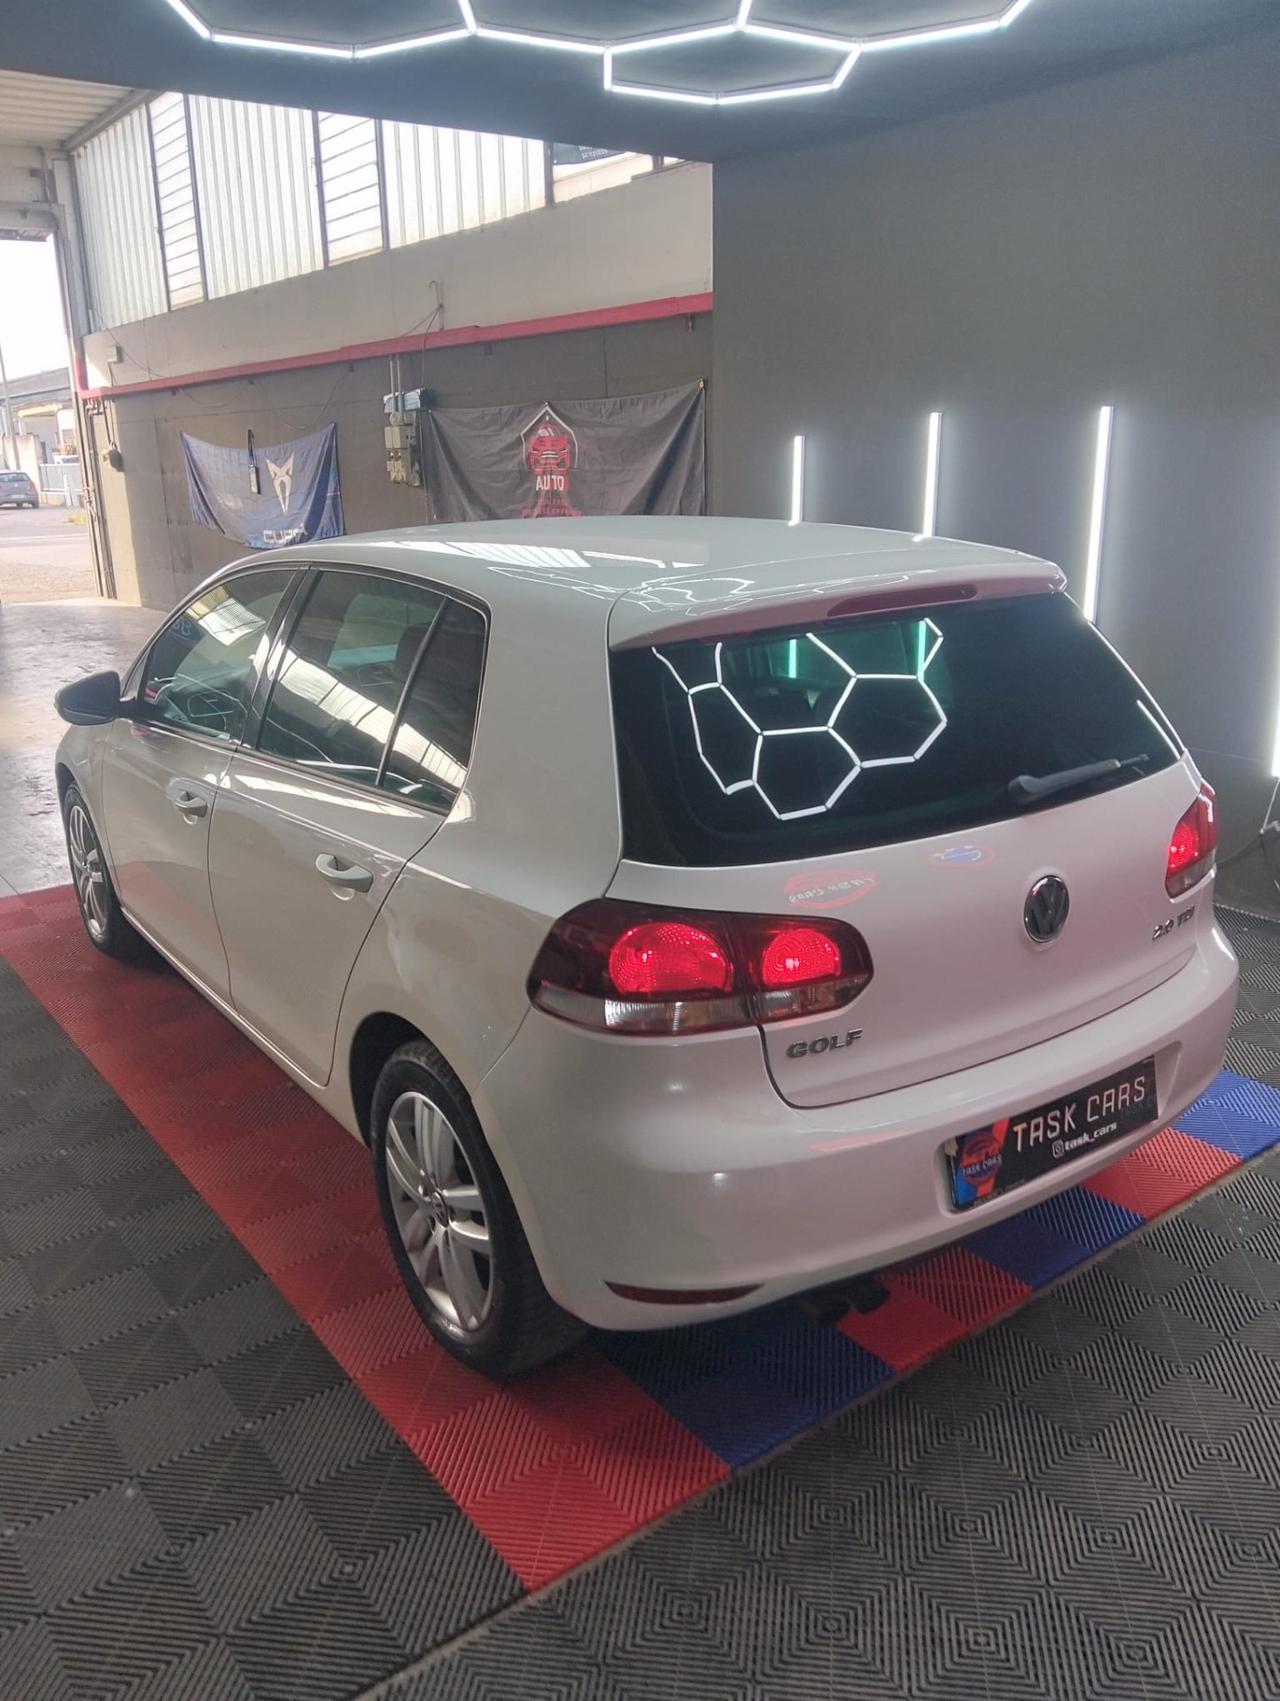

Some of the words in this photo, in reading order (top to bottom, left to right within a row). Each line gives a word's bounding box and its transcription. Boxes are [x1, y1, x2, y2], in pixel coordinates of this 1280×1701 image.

[535, 475, 564, 491] AUTO
[785, 1028, 863, 1058] GOLF
[1012, 1102, 1077, 1152] TASK
[1086, 1076, 1145, 1122] CARS
